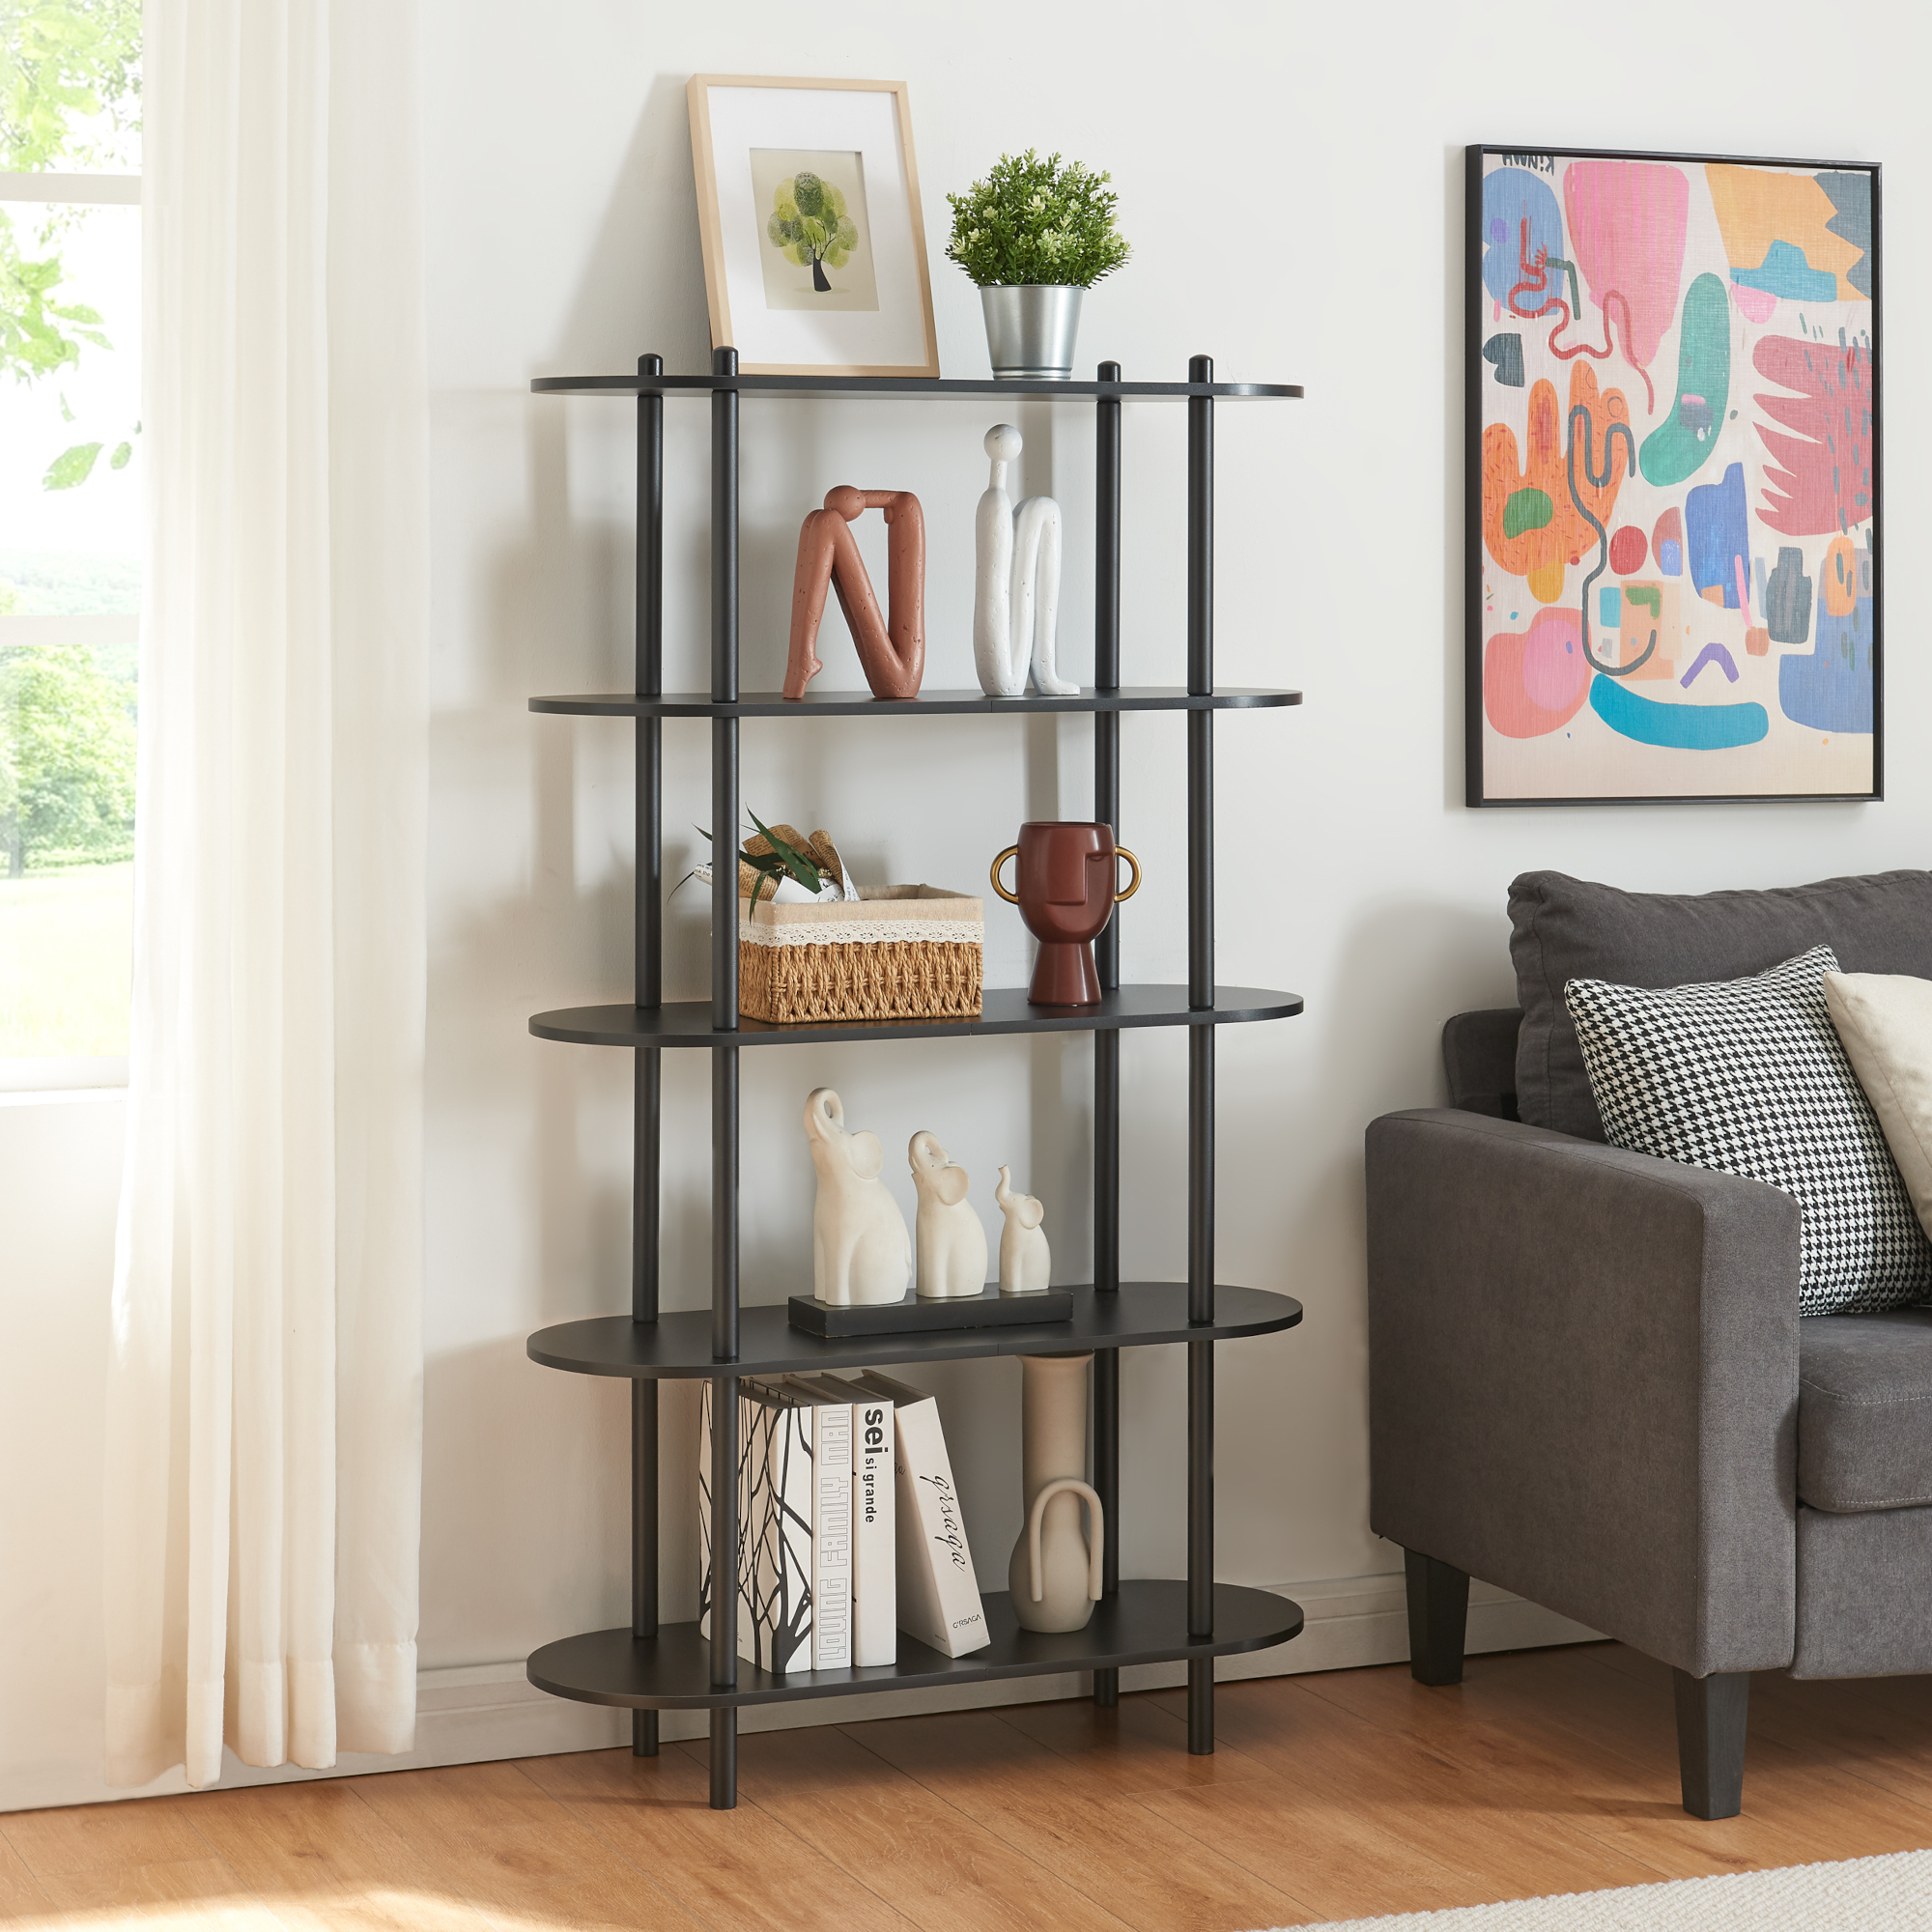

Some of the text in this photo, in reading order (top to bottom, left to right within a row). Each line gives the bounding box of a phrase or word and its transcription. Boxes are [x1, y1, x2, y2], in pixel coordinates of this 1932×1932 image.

[818, 1409, 849, 1662] LOVING FAMILY MAN
[862, 1408, 889, 1523] sei si grande
